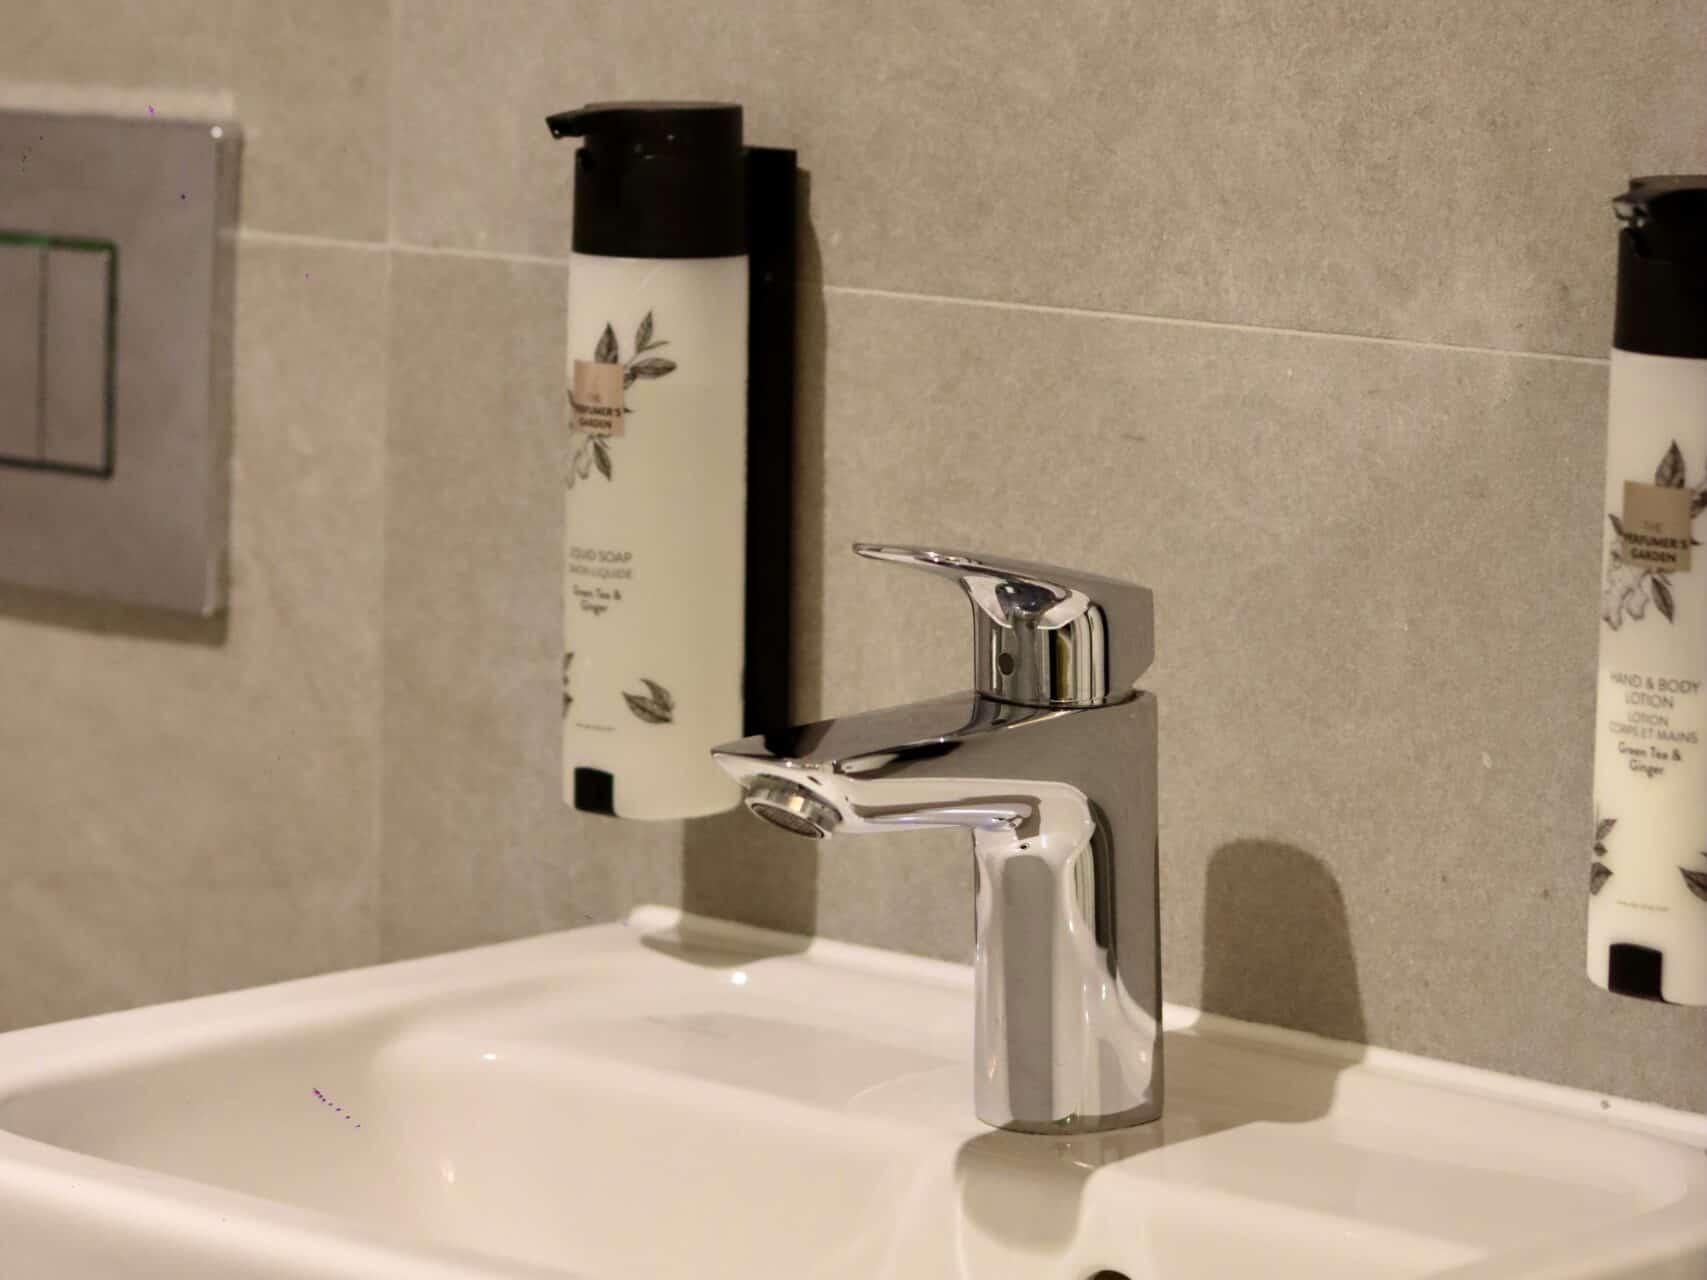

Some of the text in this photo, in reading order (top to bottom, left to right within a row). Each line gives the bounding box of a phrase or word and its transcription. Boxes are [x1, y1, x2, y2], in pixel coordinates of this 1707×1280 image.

[598, 549, 632, 563] SOAP
[1631, 547, 1676, 562] GARDEN
[1609, 673, 1702, 694] HAND & BODY
[1625, 691, 1674, 709] LOTION
[1627, 712, 1669, 727] LOTION
[1656, 730, 1698, 744] MAINS
[1618, 741, 1684, 762] Green Tea &
[1629, 758, 1665, 778] Ginger
